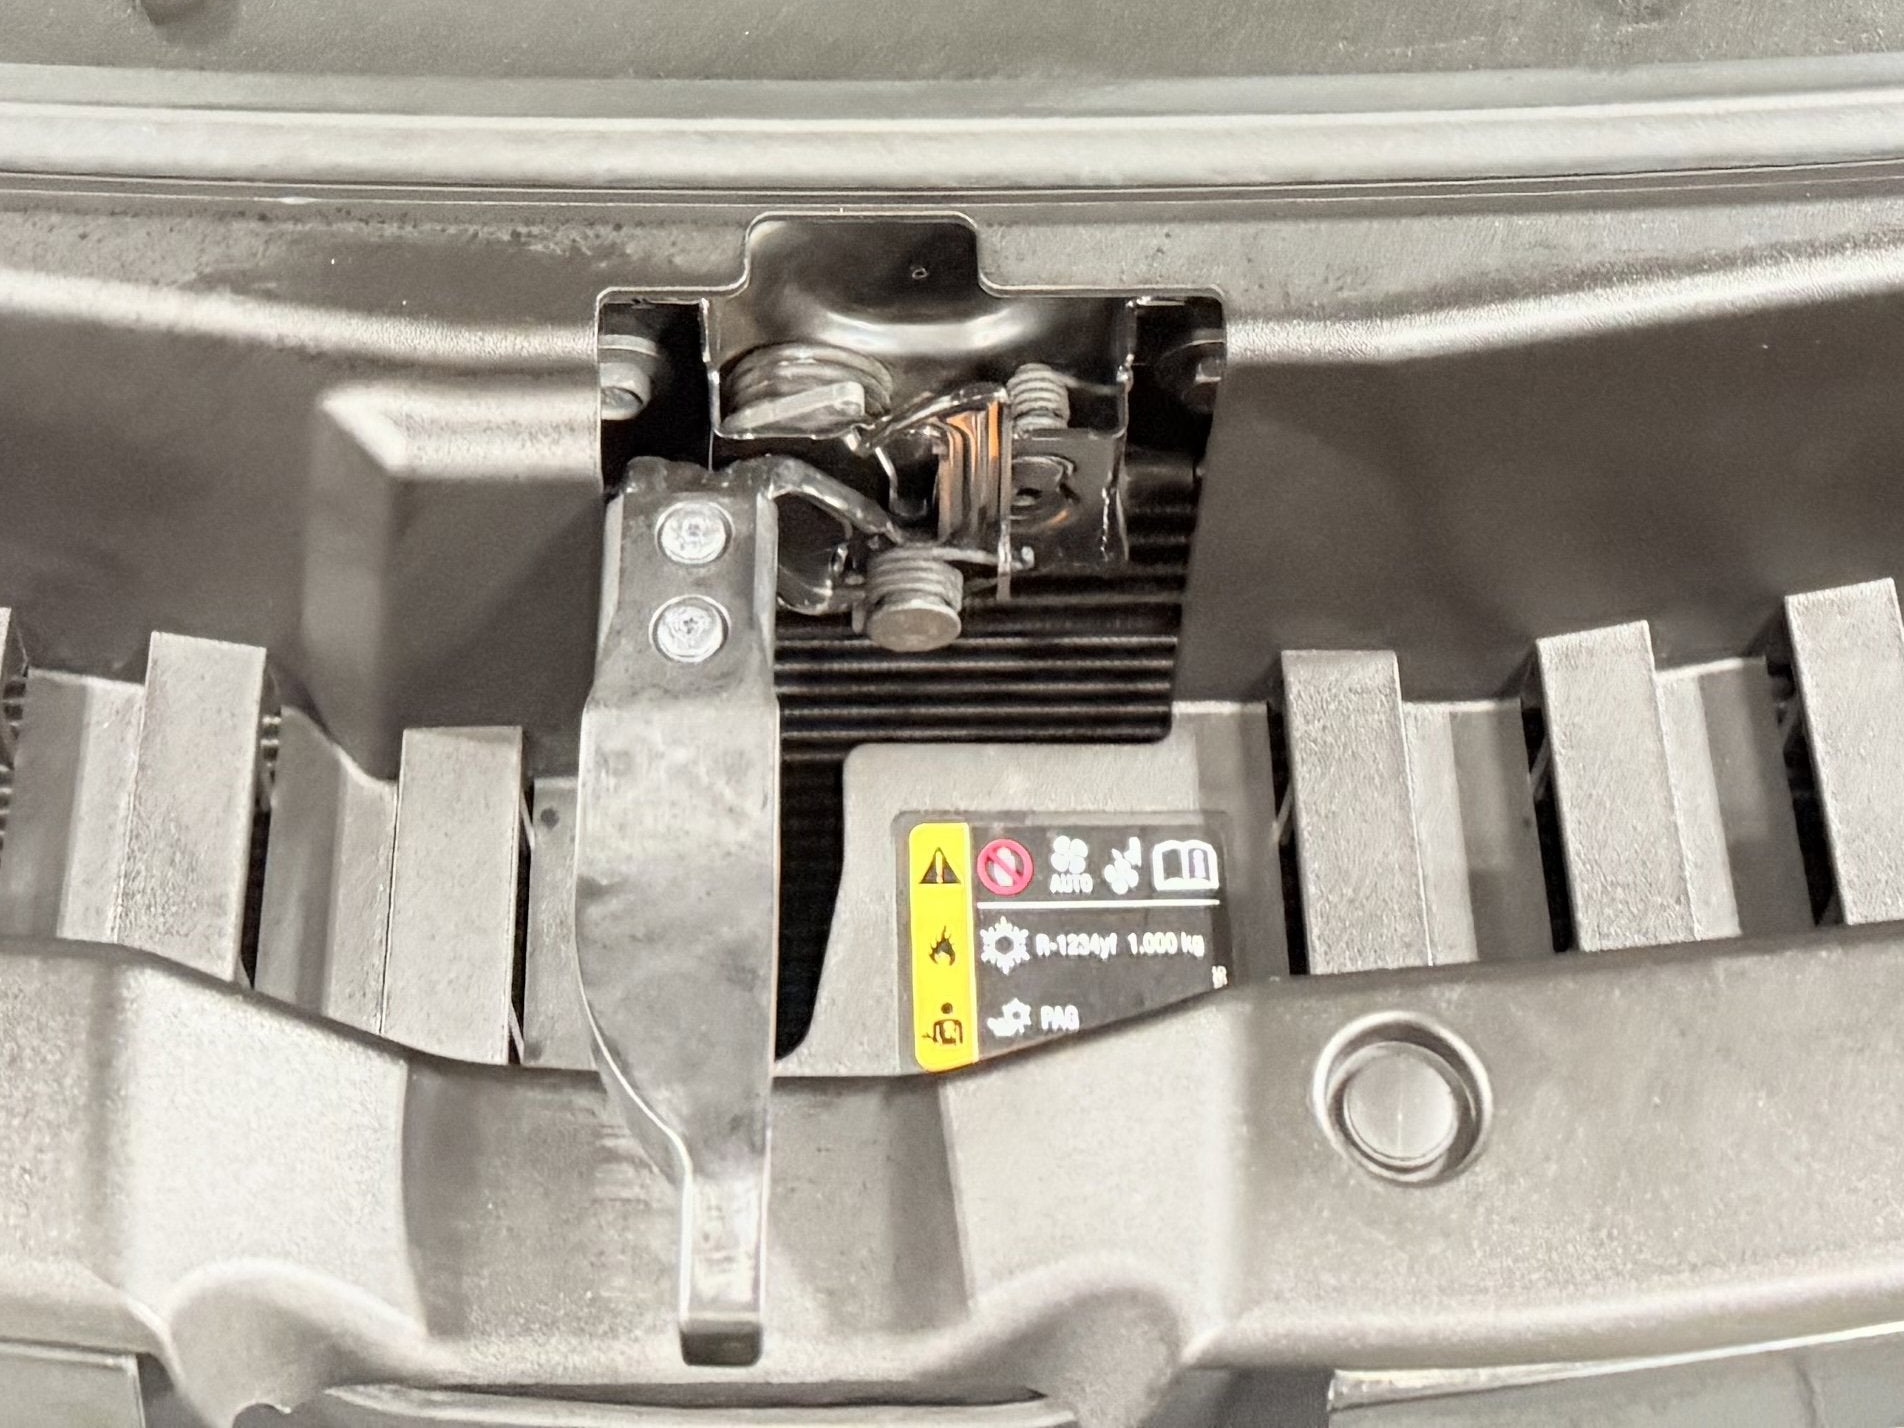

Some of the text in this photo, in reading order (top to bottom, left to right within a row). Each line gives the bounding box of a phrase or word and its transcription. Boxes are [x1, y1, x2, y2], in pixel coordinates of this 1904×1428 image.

[1050, 872, 1094, 894] AUTO
[1035, 931, 1206, 960] R-1234yf 1.000 kg
[1040, 1004, 1081, 1033] PAG
